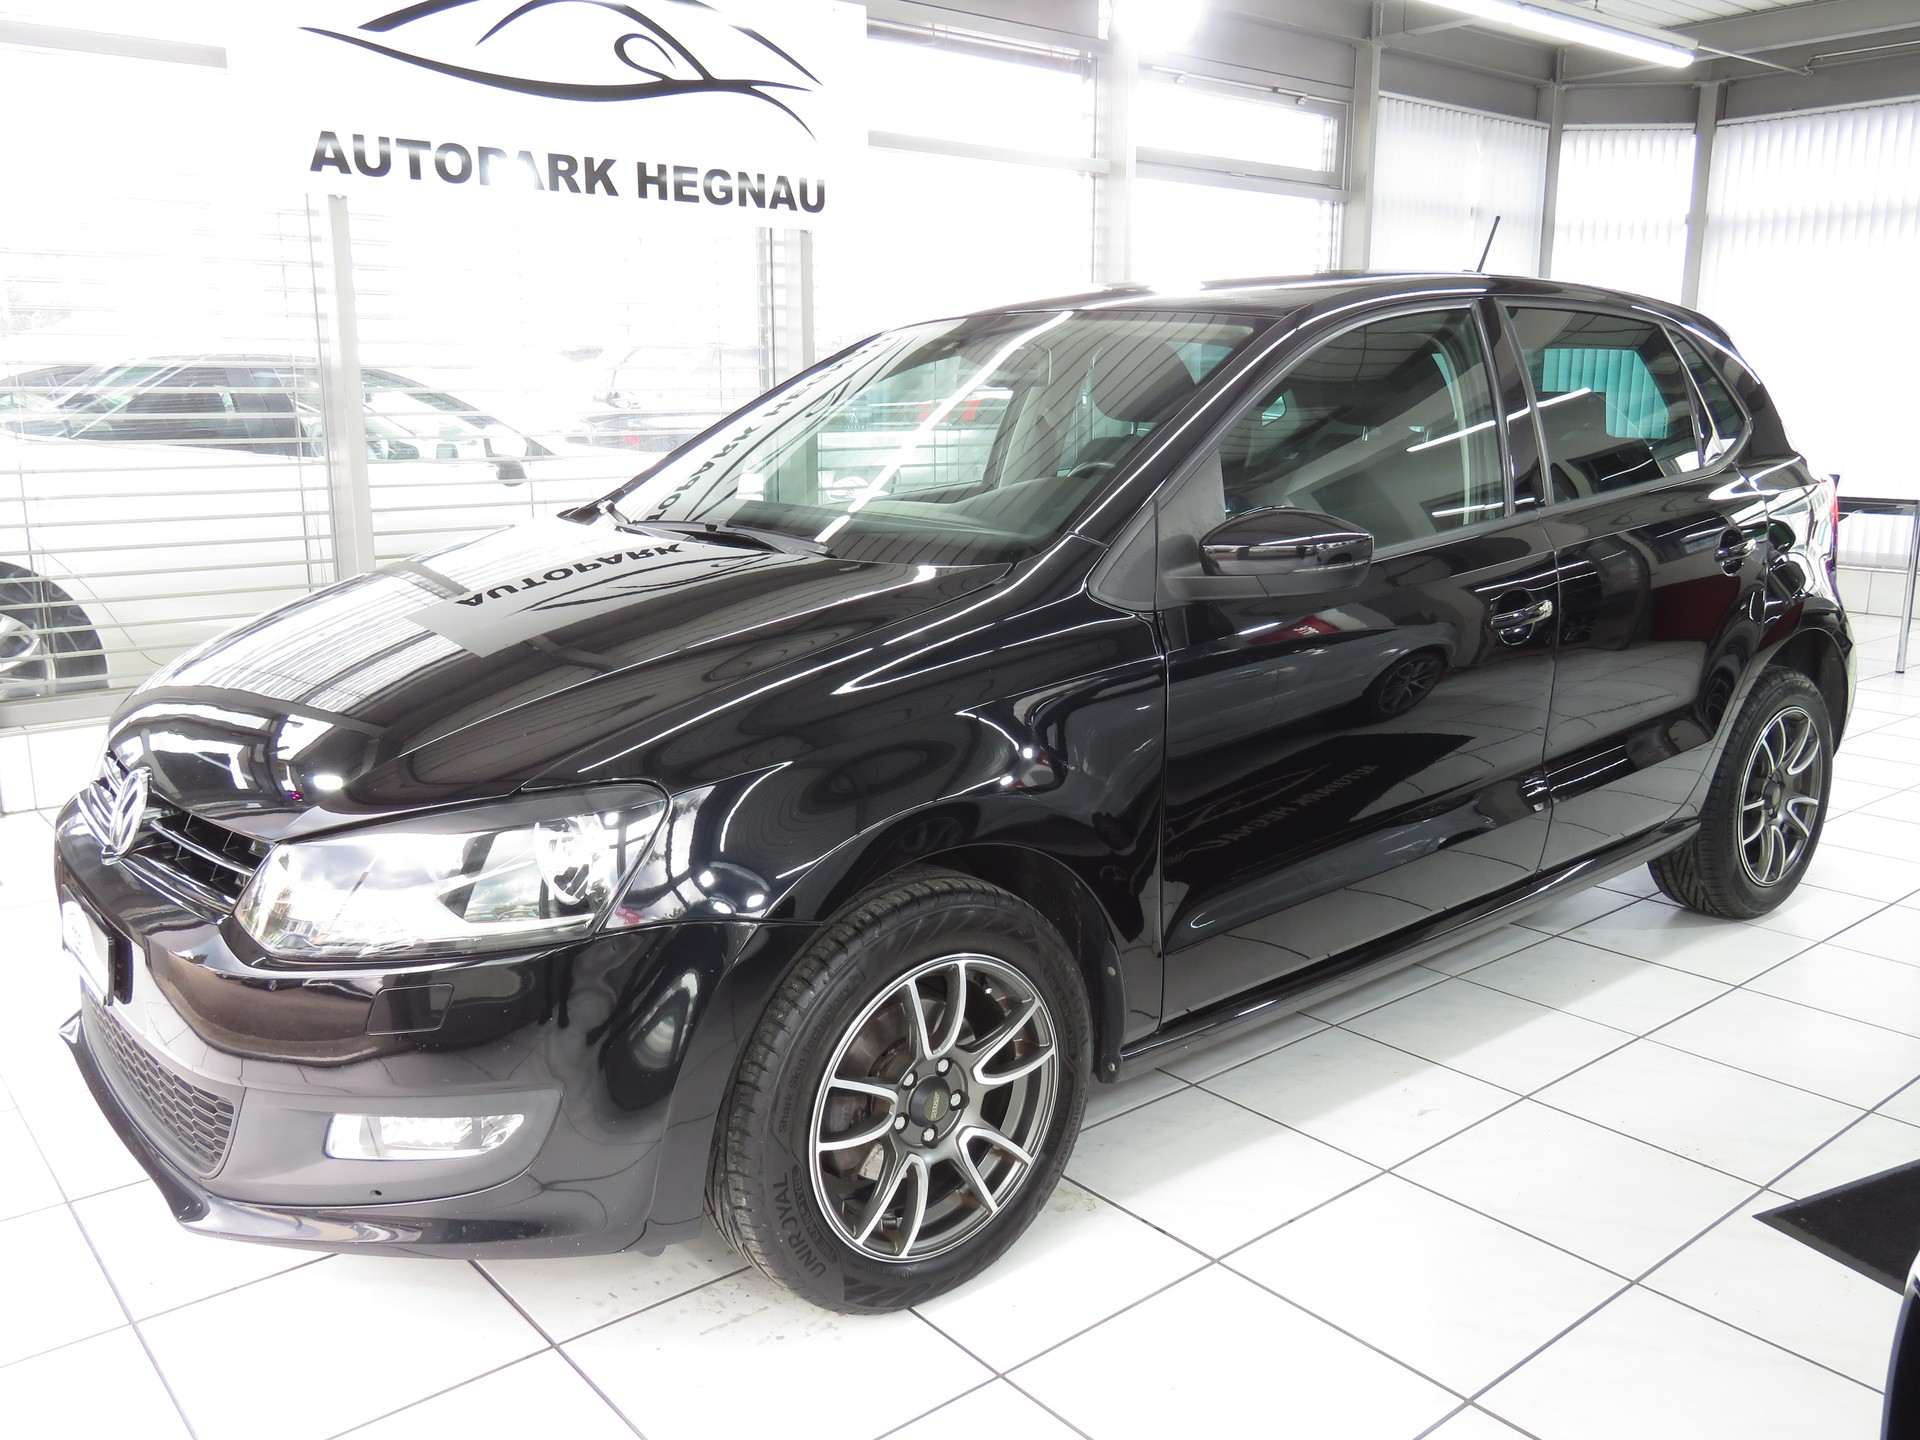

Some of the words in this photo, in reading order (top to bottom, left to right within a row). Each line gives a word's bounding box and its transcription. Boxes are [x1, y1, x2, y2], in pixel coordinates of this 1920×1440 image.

[309, 130, 619, 197] AUTOPARK
[636, 160, 826, 214] HEGNAU
[778, 1092, 794, 1134] Shark
[789, 1058, 806, 1090] Skin
[802, 983, 851, 1055] Technology
[772, 1171, 827, 1279] UNIROYAL
